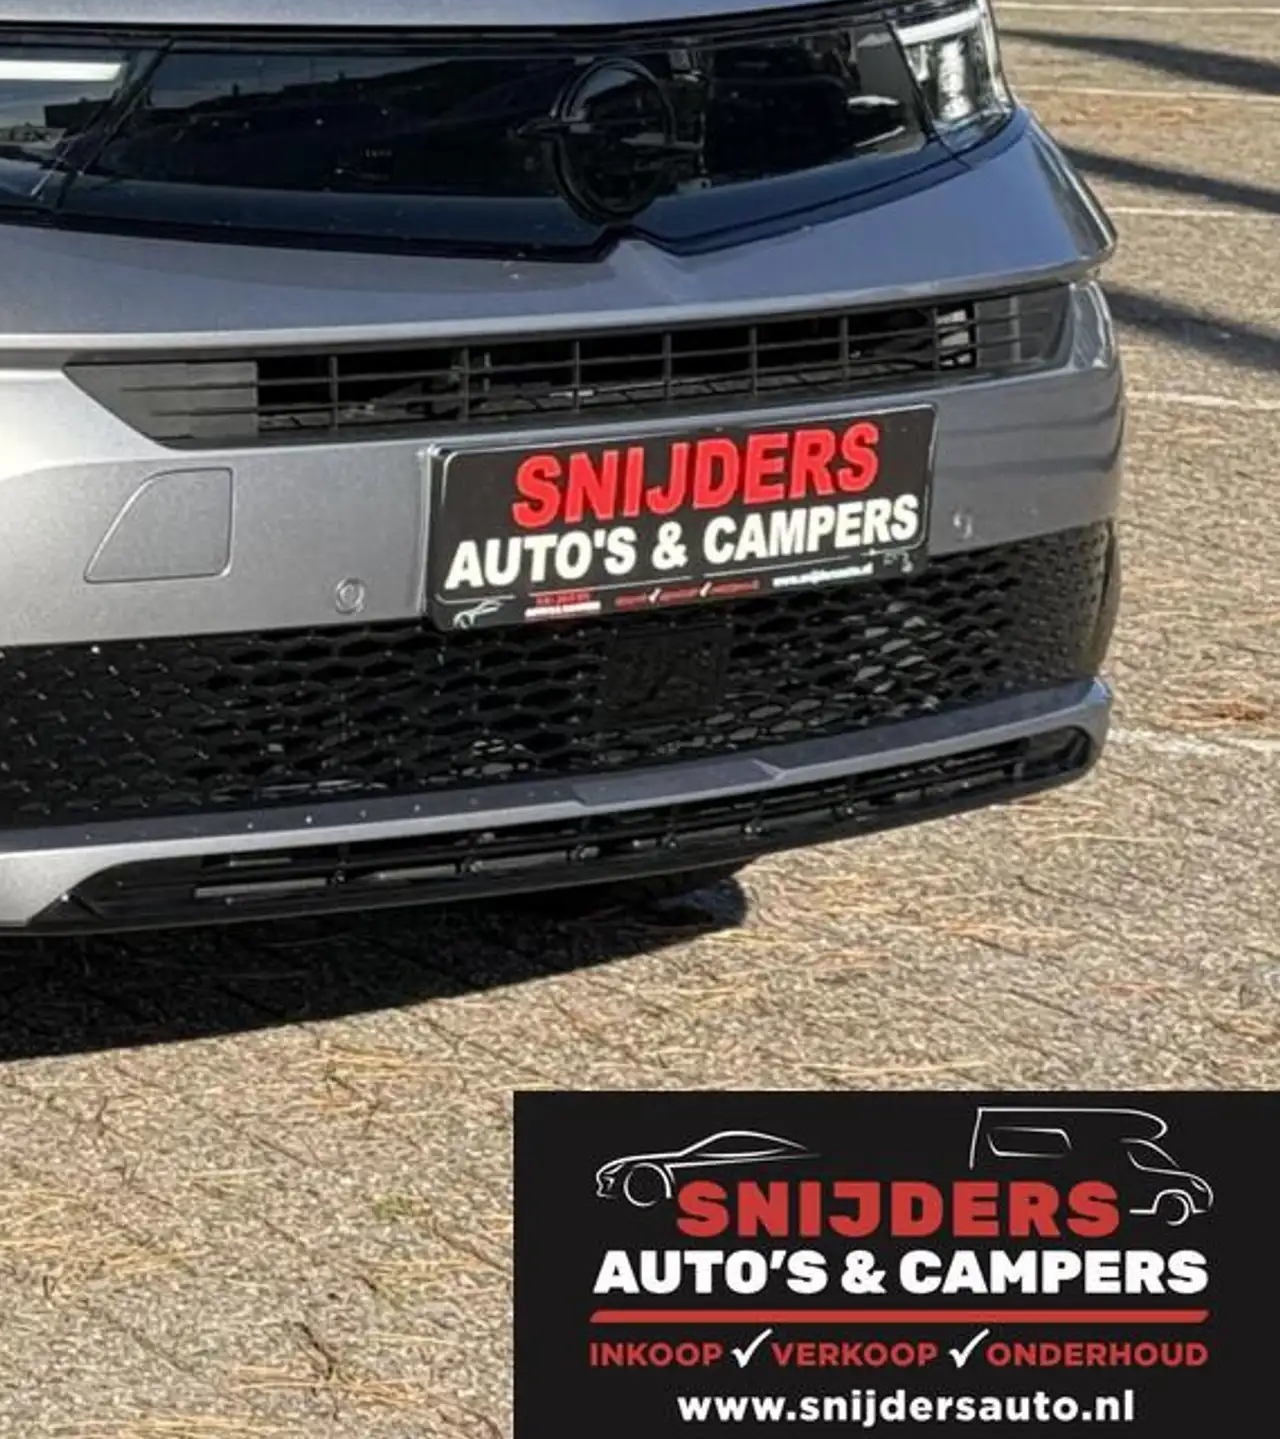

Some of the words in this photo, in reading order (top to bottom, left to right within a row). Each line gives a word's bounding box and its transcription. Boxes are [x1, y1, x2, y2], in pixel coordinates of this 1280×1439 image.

[512, 420, 880, 528] SNIJDERS
[444, 524, 638, 590] AUTO'S
[651, 521, 688, 570] &
[703, 493, 919, 564] CAMPERS
